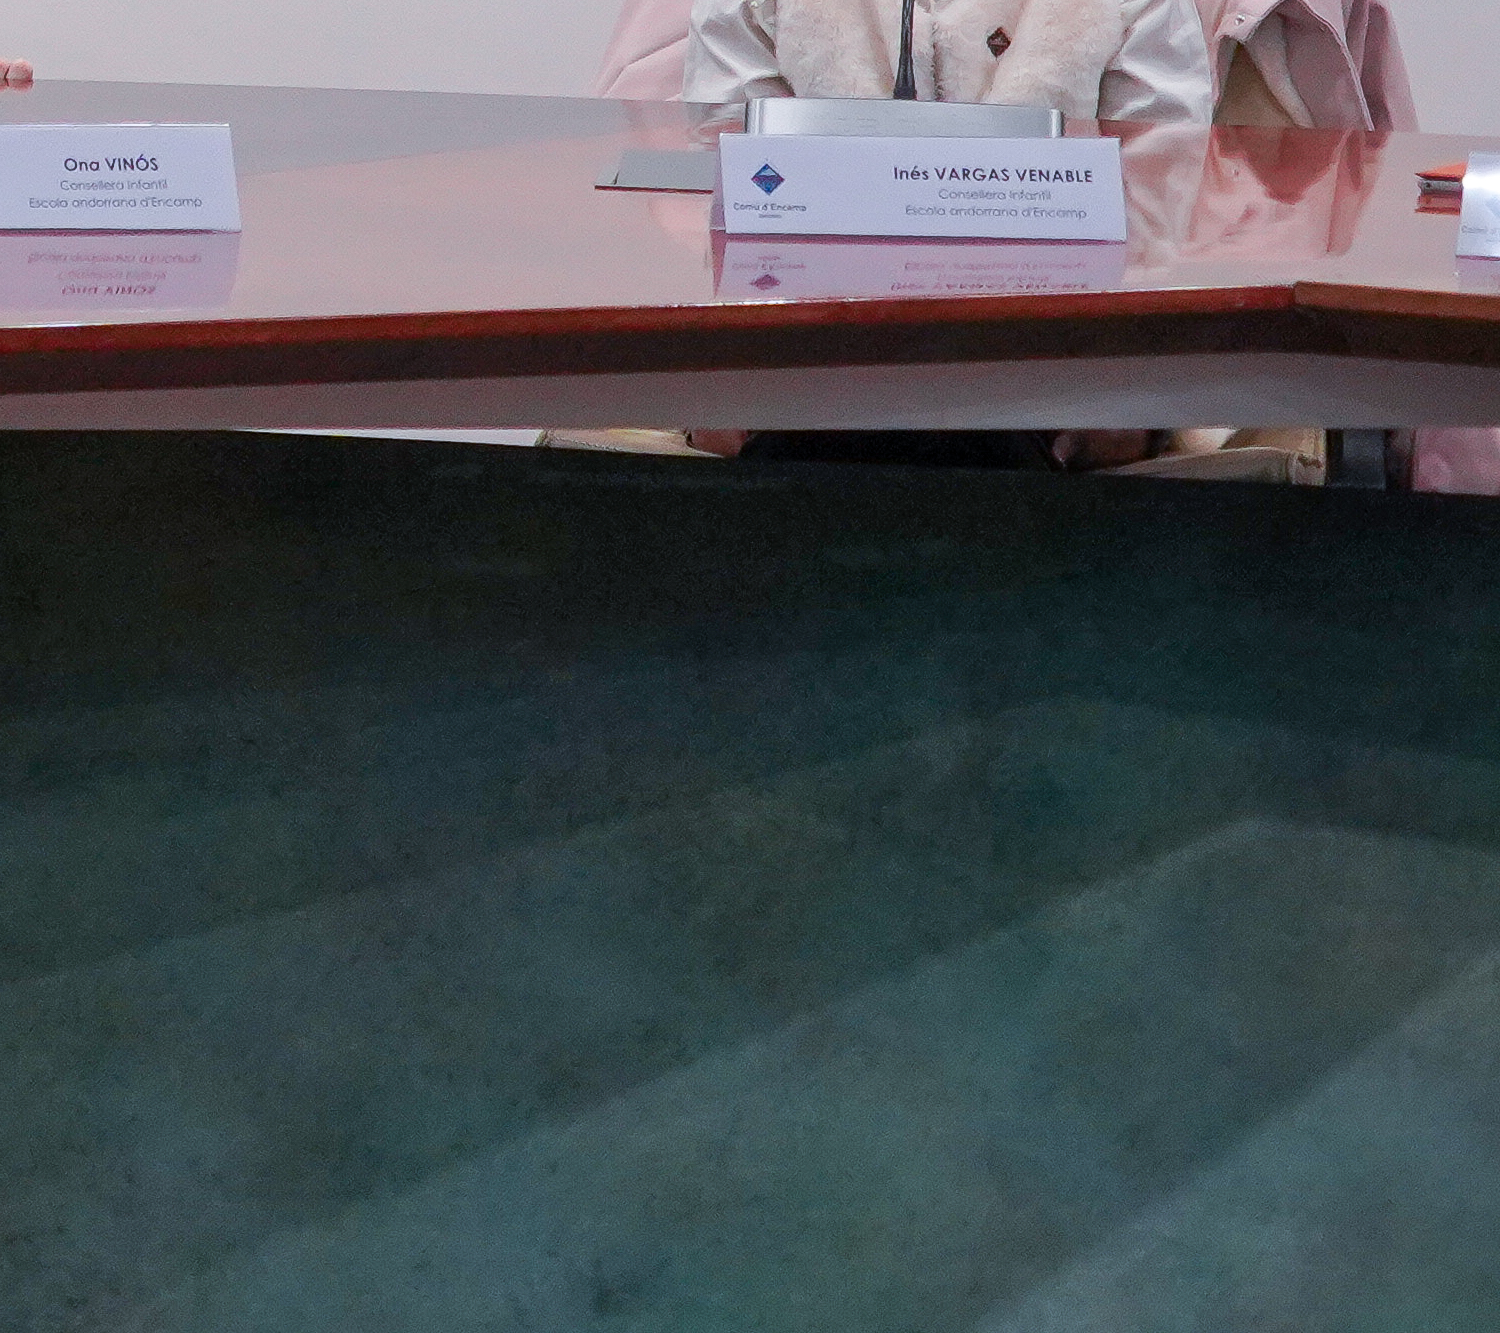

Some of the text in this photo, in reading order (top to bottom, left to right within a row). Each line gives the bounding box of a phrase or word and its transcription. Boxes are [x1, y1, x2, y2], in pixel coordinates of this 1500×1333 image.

[64, 153, 159, 172] Ona VINÓS
[893, 165, 1094, 184] Inés VARGAS VENABLE
[60, 180, 125, 192] Consellera
[29, 196, 203, 209] Escola andorrana d'Encamp
[905, 205, 946, 217] Escola
